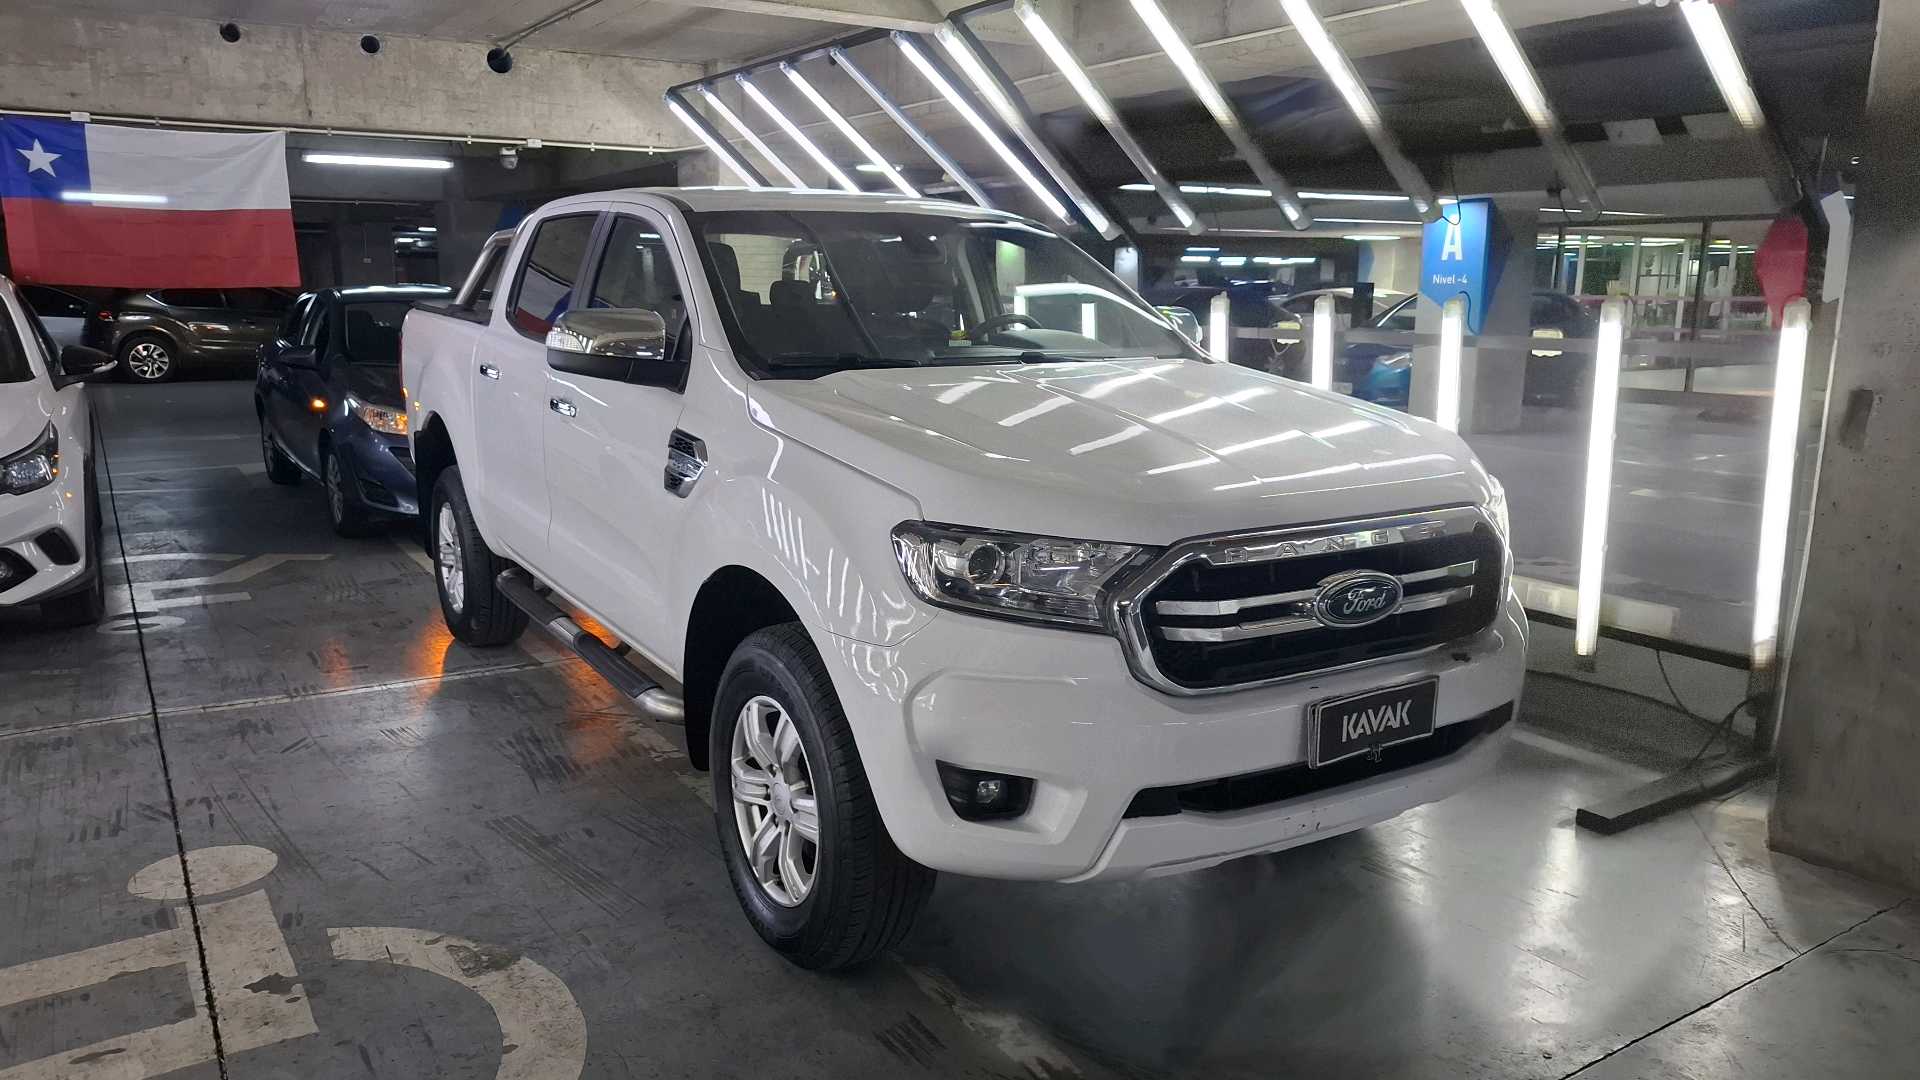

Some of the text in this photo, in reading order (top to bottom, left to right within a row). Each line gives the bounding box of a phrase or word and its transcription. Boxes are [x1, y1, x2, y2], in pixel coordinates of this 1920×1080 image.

[1441, 213, 1463, 261] A
[1432, 274, 1469, 285] Nivel -4
[1343, 586, 1387, 614] Ford
[1342, 700, 1412, 742] KAVAK
